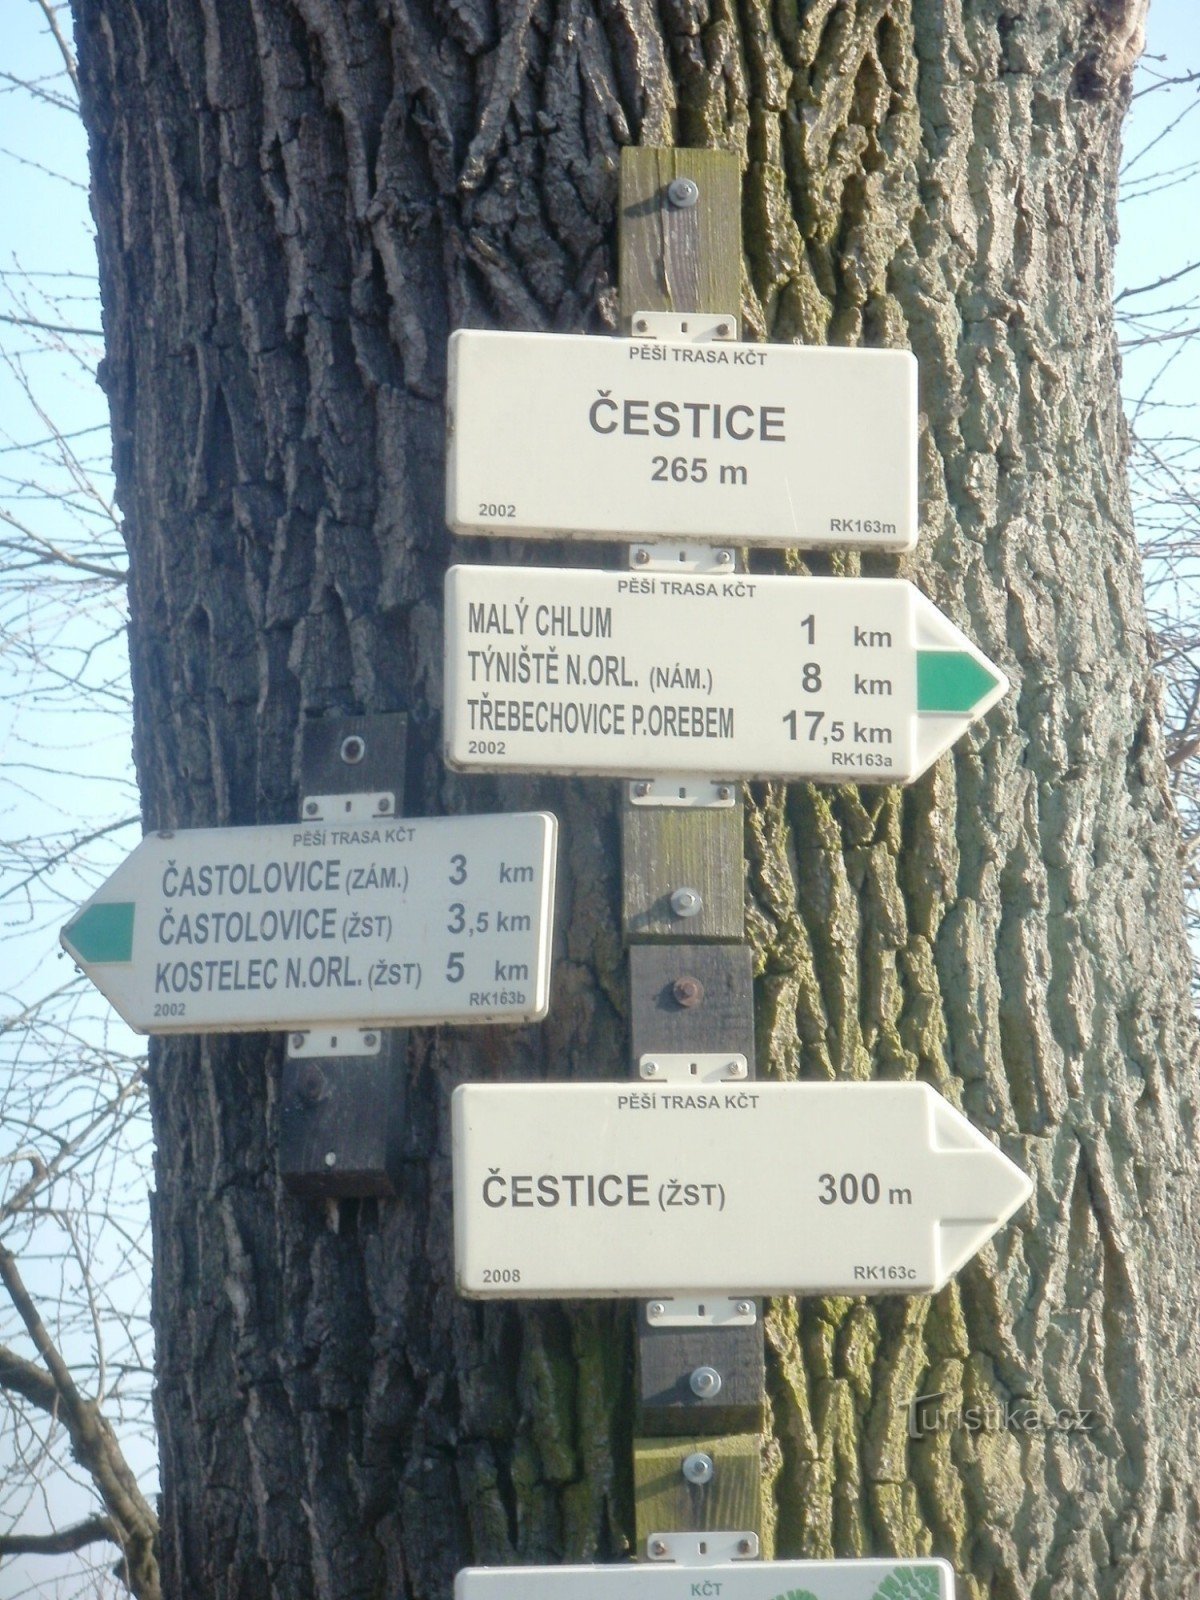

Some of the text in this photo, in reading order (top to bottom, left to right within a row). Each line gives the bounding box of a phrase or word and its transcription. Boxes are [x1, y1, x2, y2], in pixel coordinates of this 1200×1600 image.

[630, 345, 767, 365] PĚŠÍ TRASA KČT
[589, 390, 785, 442] ČESTICE
[652, 456, 747, 485] 265 m
[479, 504, 516, 517] 2002
[831, 519, 896, 533] RK163m
[618, 578, 756, 597] PĚŠÍ TRASA KČT
[469, 597, 891, 647] MALÝ CHLUM 1 km
[468, 645, 892, 695] TÝNIŠTĚ N.ORL. (NÁM.) 8 km
[467, 692, 892, 745] TŘEBECHOVICE P.OREBEM 17,5 km
[469, 741, 505, 754] 2002
[832, 752, 892, 767] RK163a
[293, 825, 416, 846] PĚŠÍ TRASA KČT
[163, 854, 533, 897] ČASTOLOVICE (ZÁM.) 3 km
[159, 903, 530, 945] ČASTOLOVICE (ŽST) 3,5 km
[155, 952, 528, 993] KOSTELEC N.ORL. (ŽST) 5 km
[470, 991, 525, 1006] RK163b
[154, 1003, 185, 1017] 2002
[618, 1092, 759, 1109] PĚŠÍ TRASA KČT
[483, 1168, 911, 1212] ČESTICE (ŽST) 300 m
[483, 1269, 520, 1283] 2008
[854, 1266, 916, 1279] RK163c
[691, 1581, 722, 1596] KČT
